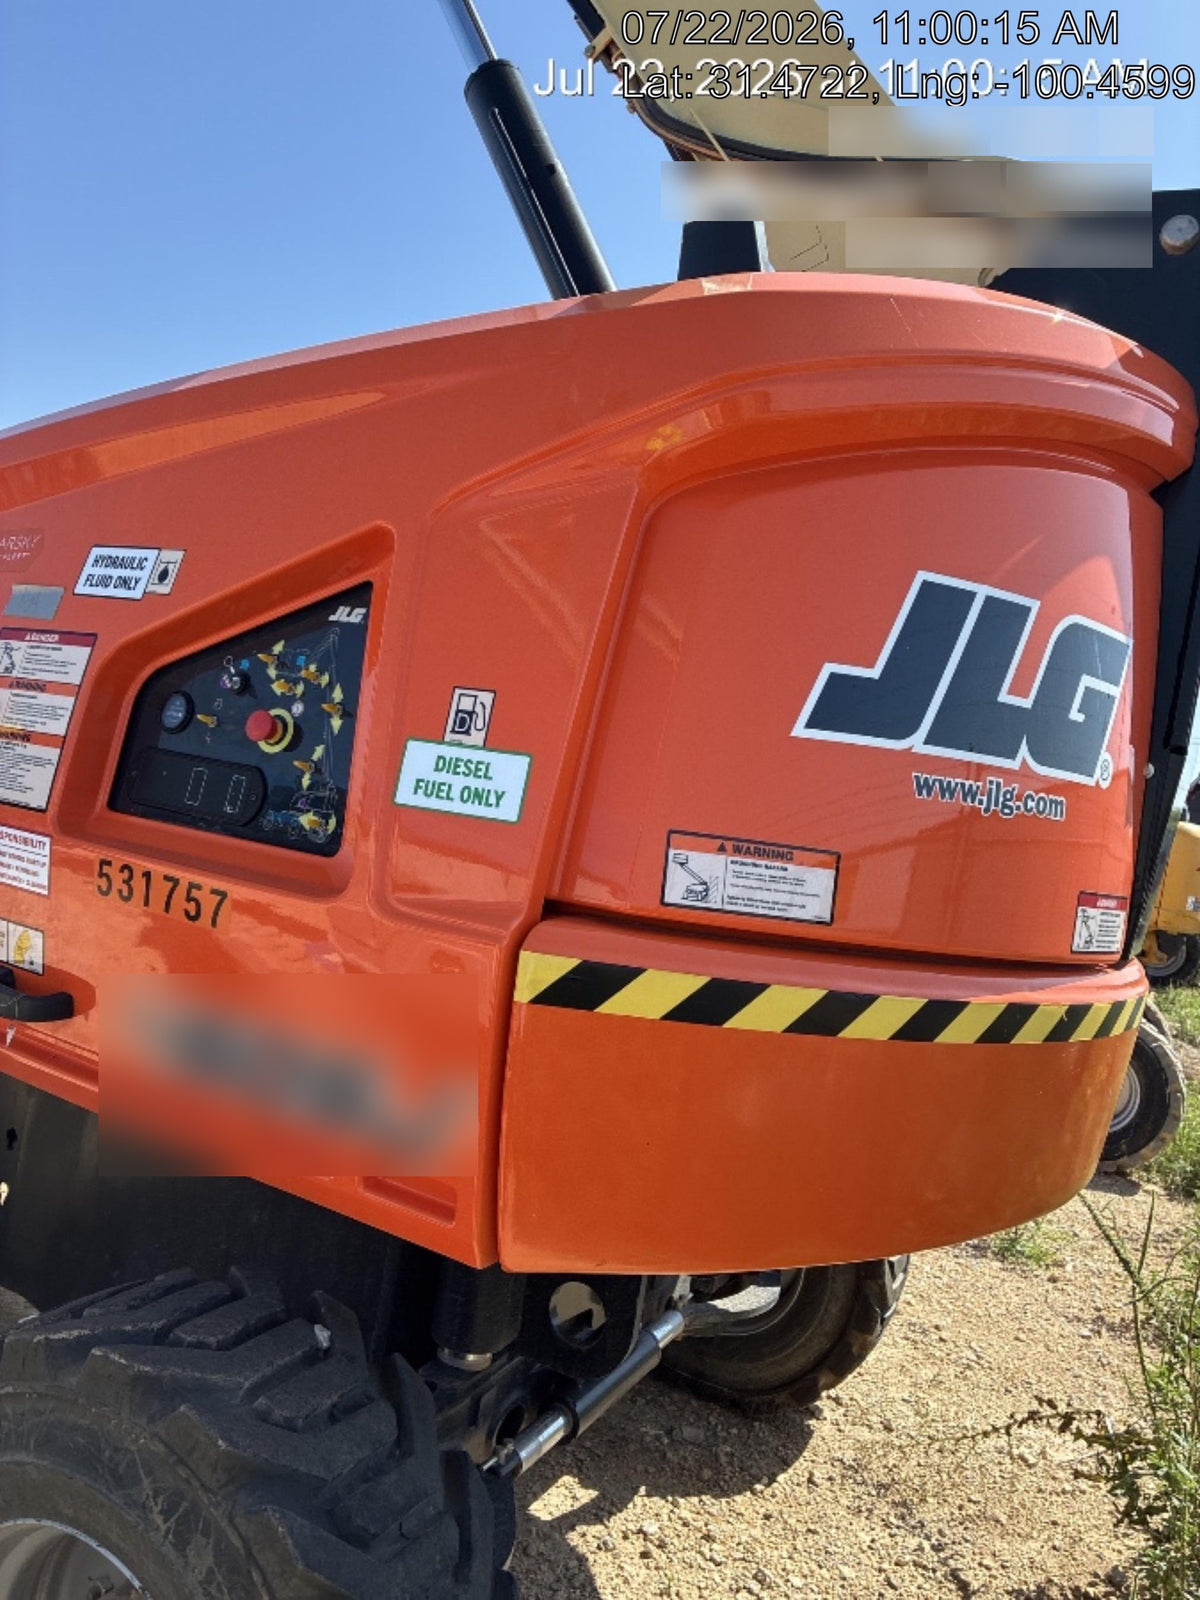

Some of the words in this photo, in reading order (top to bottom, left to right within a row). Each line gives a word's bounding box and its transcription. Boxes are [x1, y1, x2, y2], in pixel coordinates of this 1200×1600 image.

[91, 554, 148, 571] HYDRAULIC
[83, 573, 113, 589] FLUID
[113, 576, 142, 592] ONLY
[328, 606, 367, 623] JLG
[789, 570, 1134, 786] JLG
[433, 755, 493, 780] DIESEL
[413, 778, 454, 802] FUEL
[459, 785, 506, 808] ONLY
[912, 773, 1066, 821] www.jlg.com
[732, 844, 794, 861] WARNING
[96, 858, 229, 929] 531757
